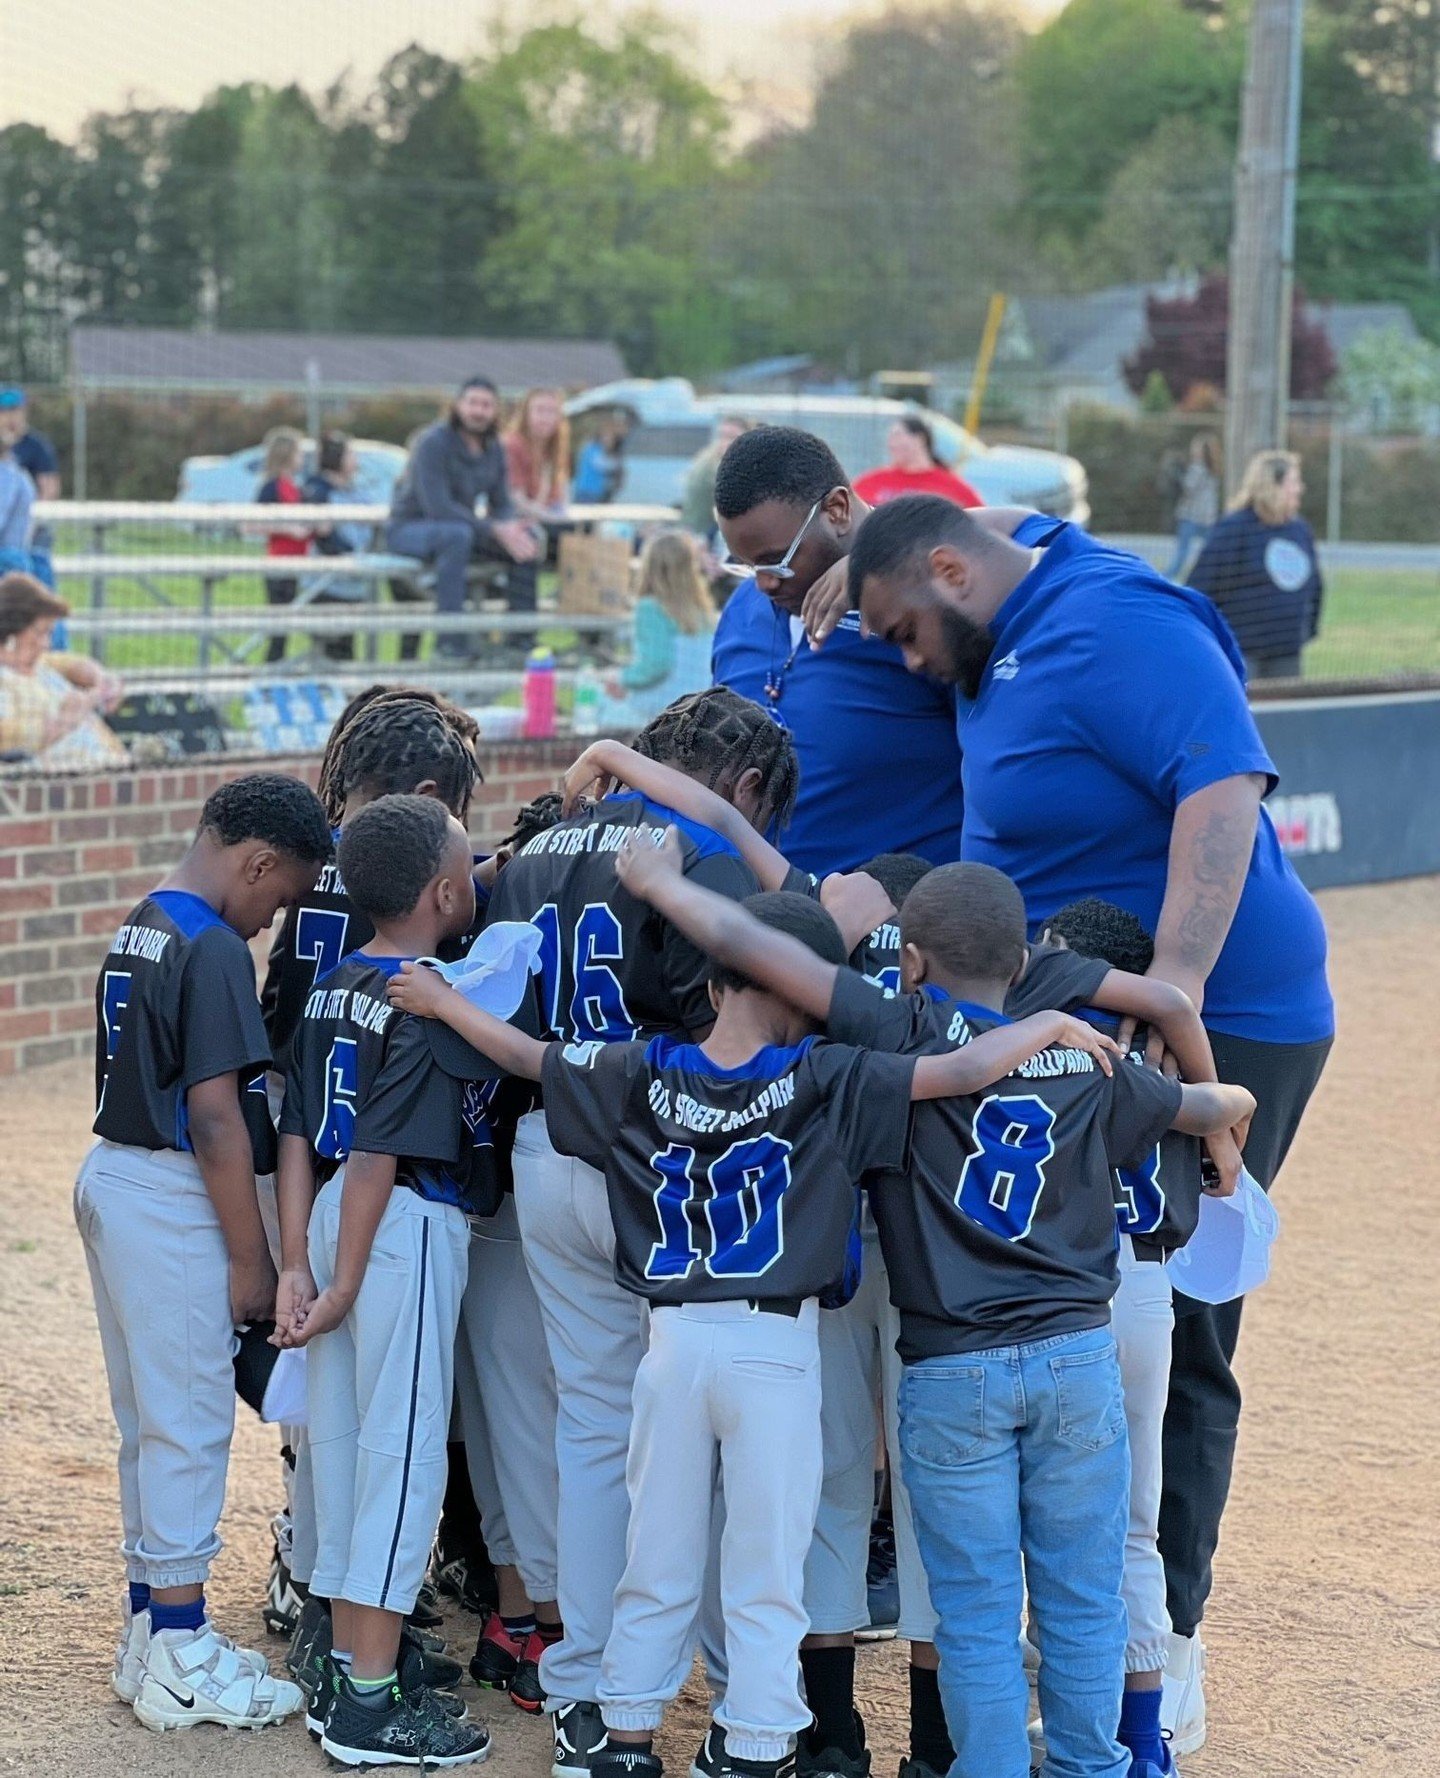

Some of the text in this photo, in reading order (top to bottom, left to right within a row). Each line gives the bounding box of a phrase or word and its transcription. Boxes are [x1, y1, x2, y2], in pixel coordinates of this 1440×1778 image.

[296, 907, 350, 986] 7
[674, 1092, 726, 1134] STREET
[954, 1094, 1057, 1243] 8
[644, 1131, 793, 1280] 10
